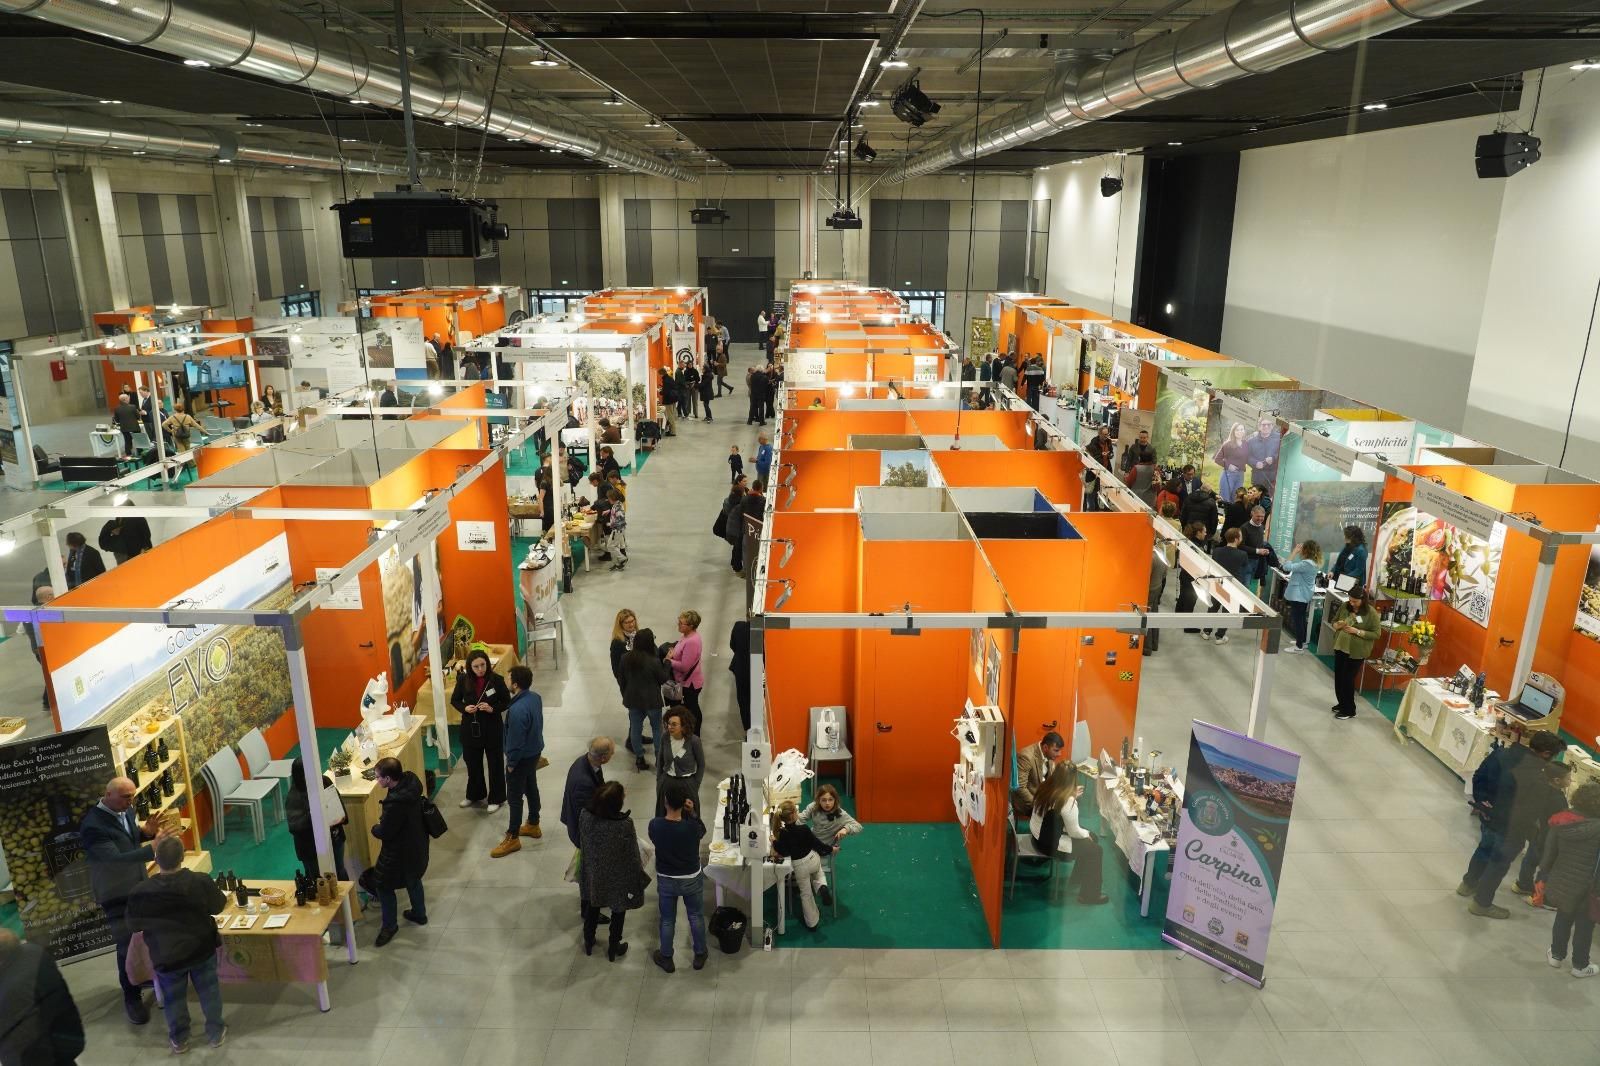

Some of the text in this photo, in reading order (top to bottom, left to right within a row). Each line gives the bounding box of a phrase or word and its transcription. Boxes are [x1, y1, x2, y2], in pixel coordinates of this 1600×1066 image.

[1354, 436, 1408, 448] Semplicità
[168, 636, 232, 714] EVO
[13, 759, 34, 768] Extra
[36, 753, 65, 763] Vergine
[67, 749, 75, 757] di
[76, 745, 100, 754] Oliva,
[73, 762, 108, 774] Autentica
[1185, 839, 1263, 888] Carpino
[1202, 898, 1219, 911] degli
[1220, 907, 1243, 920] eventi
